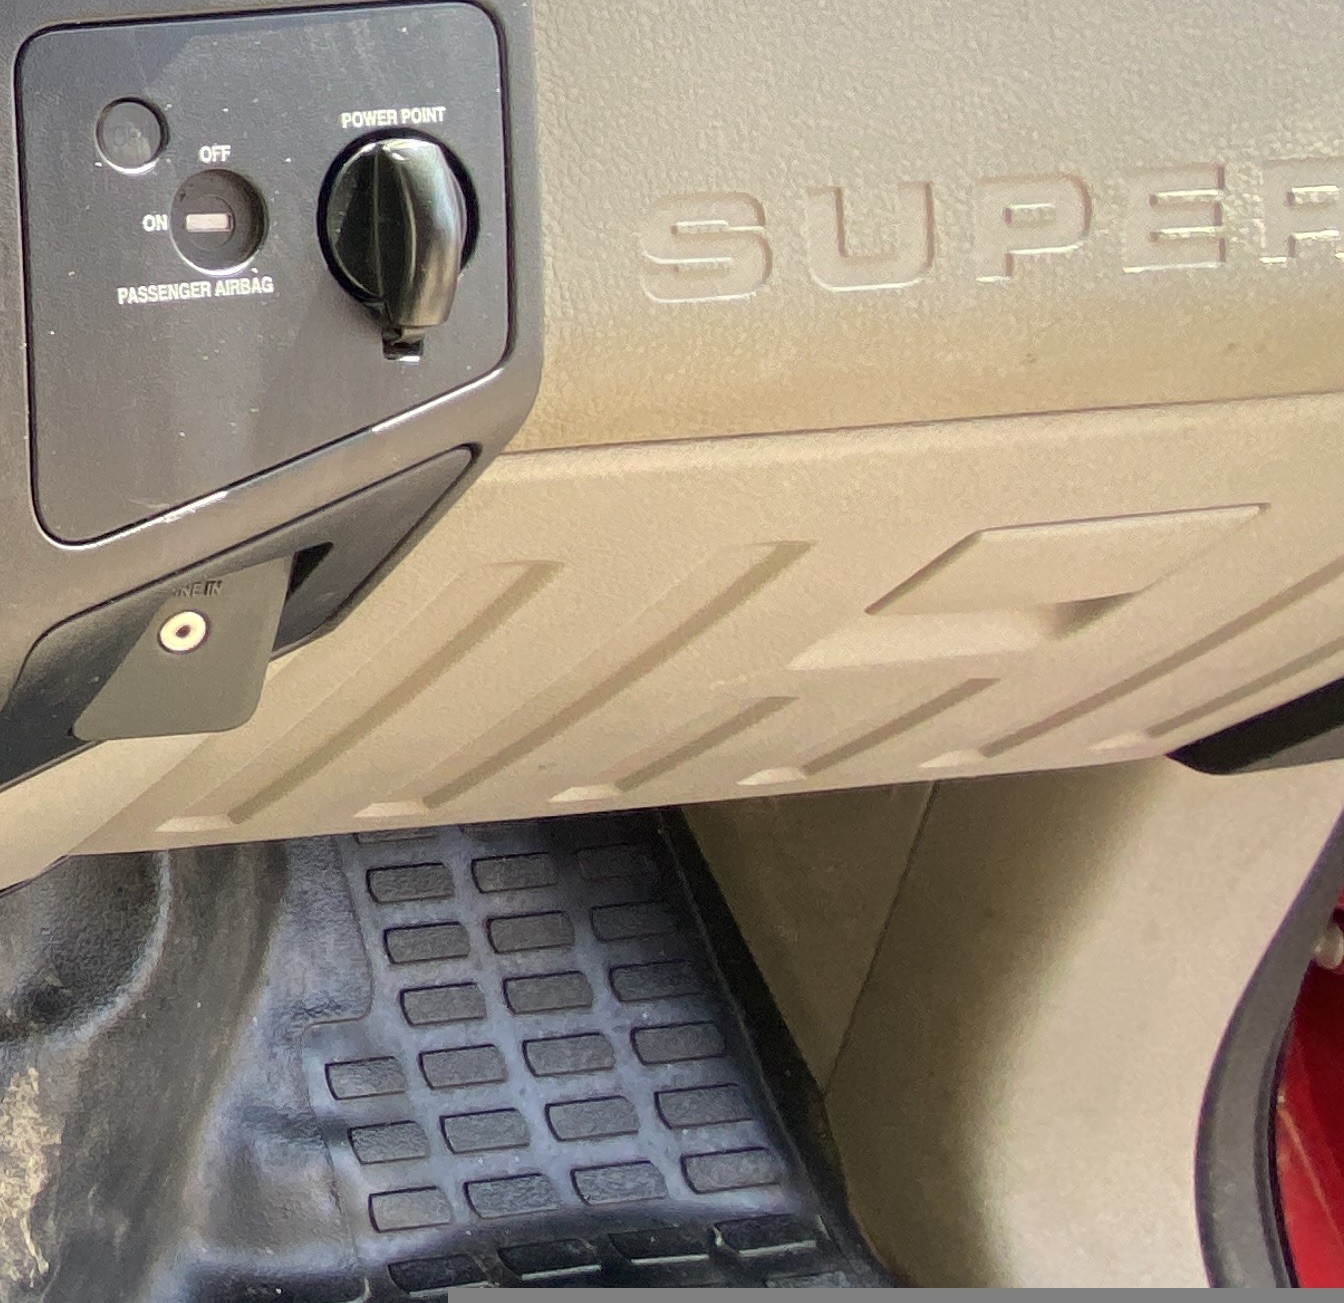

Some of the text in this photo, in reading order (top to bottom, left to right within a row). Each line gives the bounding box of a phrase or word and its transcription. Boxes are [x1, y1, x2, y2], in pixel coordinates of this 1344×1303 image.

[340, 106, 447, 129] POWER POINT
[198, 145, 231, 163] OFF
[142, 215, 168, 232] ON
[117, 276, 274, 305] PASSENGER AIRBAG
